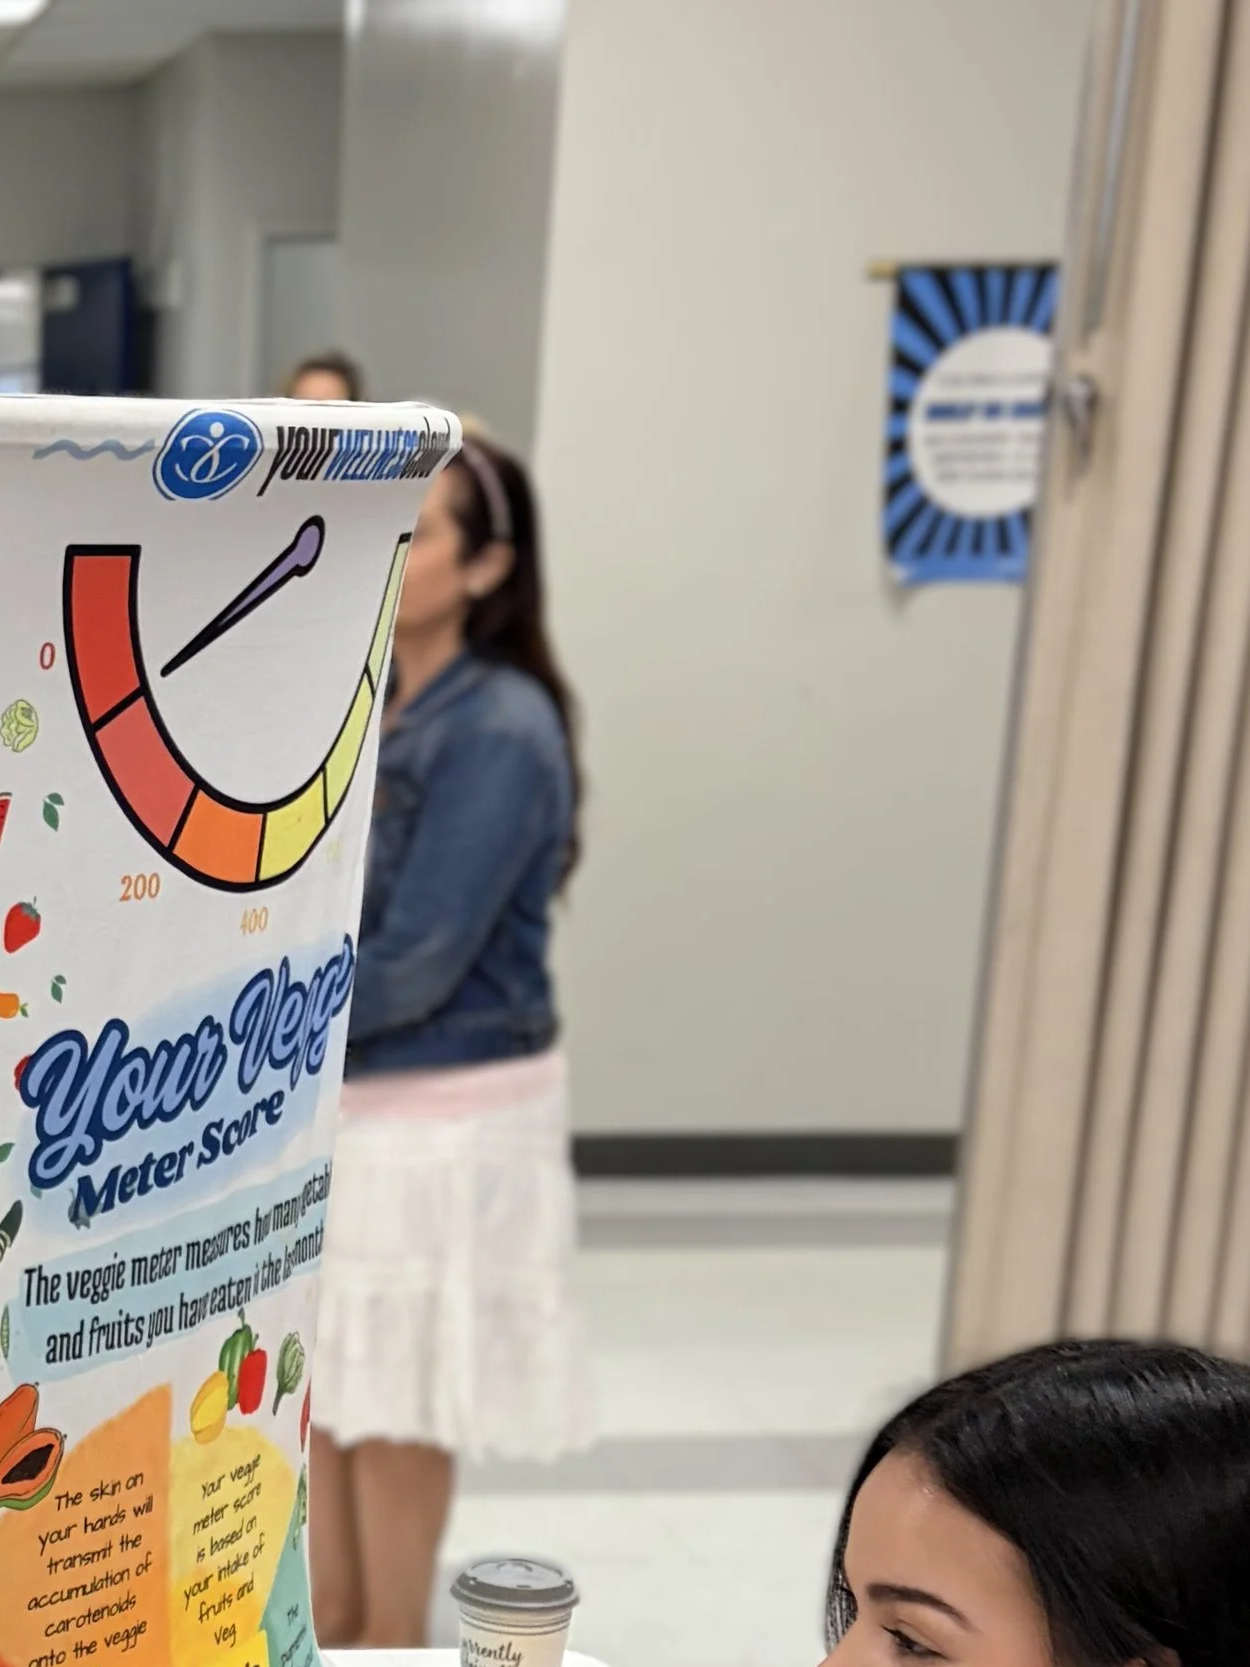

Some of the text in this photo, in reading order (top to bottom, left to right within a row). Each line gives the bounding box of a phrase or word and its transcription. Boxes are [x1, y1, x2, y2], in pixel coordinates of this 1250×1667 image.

[39, 642, 55, 669] 0
[120, 873, 160, 902] 200
[240, 907, 268, 936] 400
[20, 1015, 228, 1189] Your
[73, 1090, 285, 1219] Meter Score
[24, 1265, 61, 1307] The
[66, 1252, 125, 1304] veggie
[131, 1243, 181, 1288] meter
[185, 1220, 251, 1271] measures
[46, 1320, 84, 1364] and
[88, 1309, 144, 1356] fruits
[147, 1306, 173, 1349] you
[210, 1275, 252, 1315] eaten
[260, 1252, 282, 1292] the
[55, 1472, 143, 1511] The skin on
[192, 1482, 261, 1535] meter score
[38, 1495, 153, 1556] your hands will
[196, 1546, 205, 1563] is
[210, 1517, 244, 1556] based
[47, 1533, 142, 1575] transmit the
[183, 1532, 265, 1611] your intake of
[27, 1551, 153, 1611] accumulation of
[198, 1571, 254, 1624] fruits and
[45, 1590, 136, 1637] carotenoids
[73, 1640, 97, 1659] the
[104, 1620, 147, 1653] veggie
